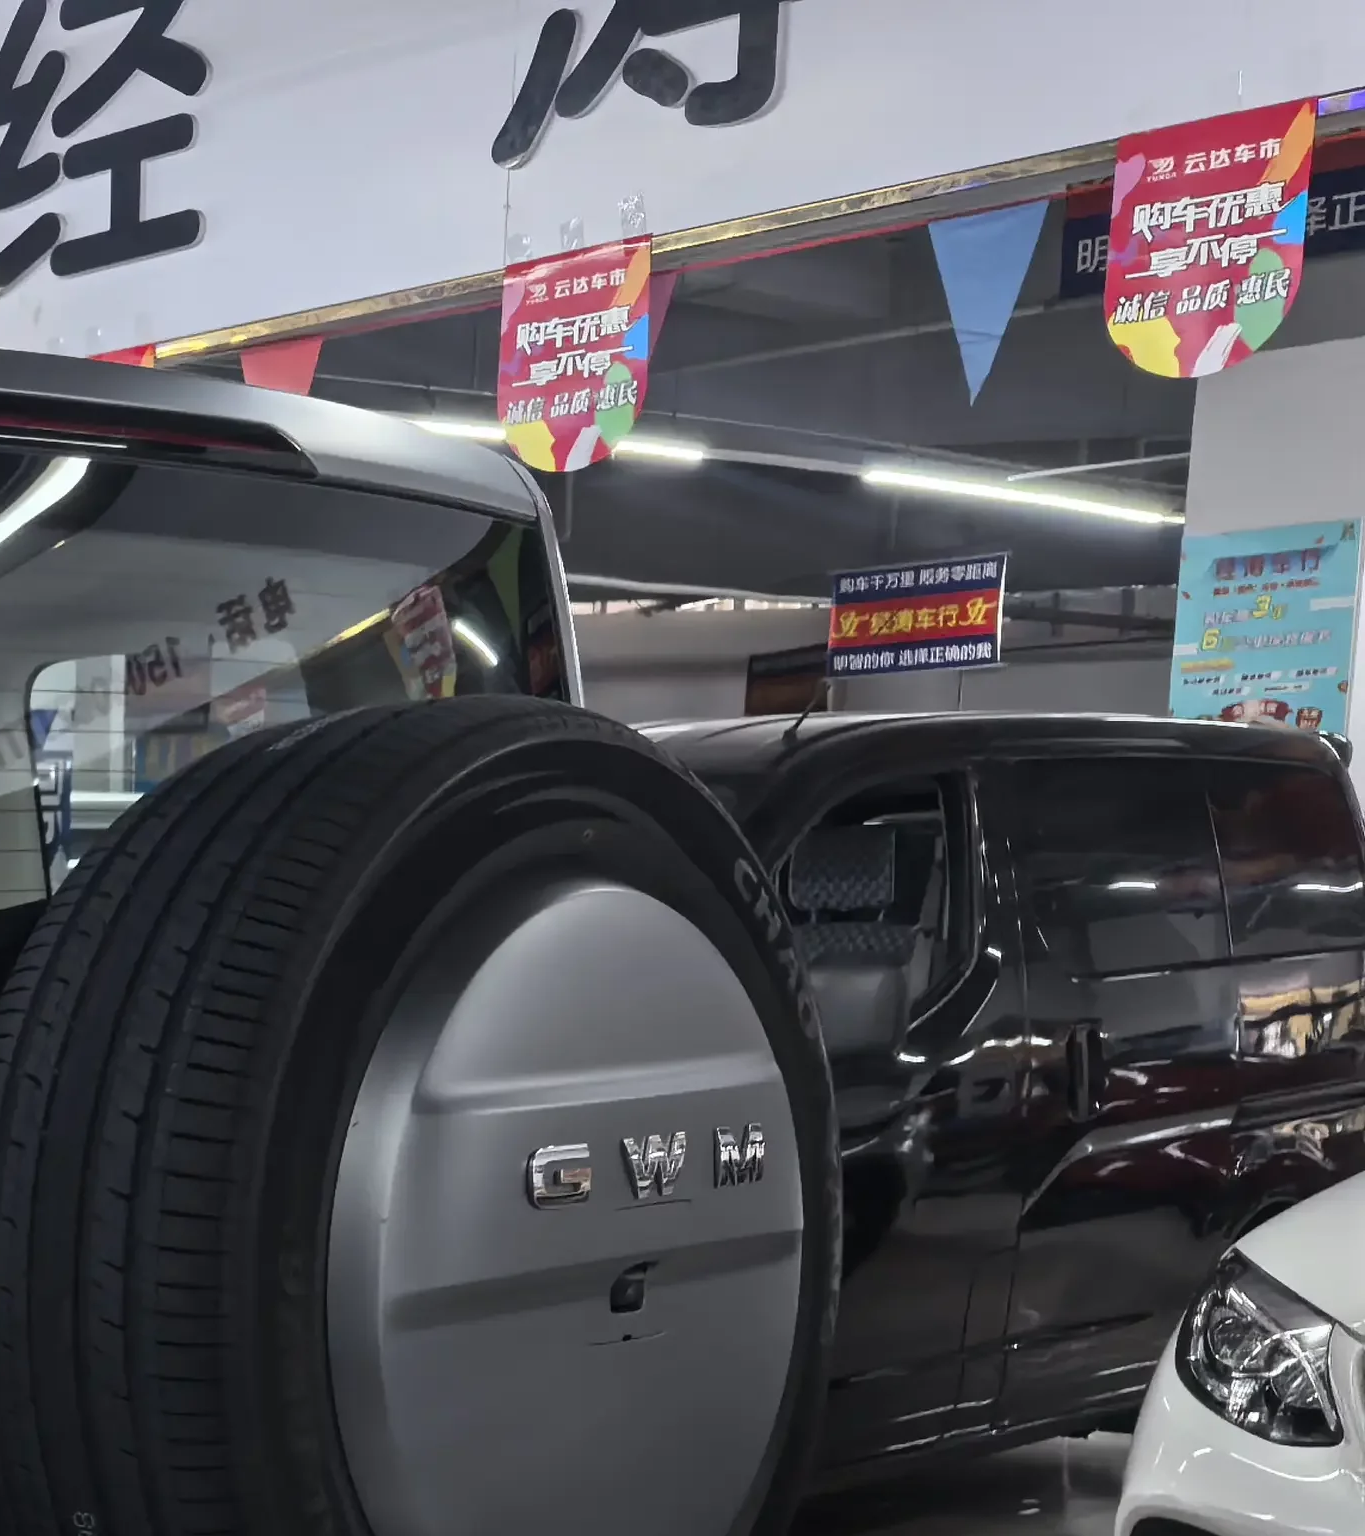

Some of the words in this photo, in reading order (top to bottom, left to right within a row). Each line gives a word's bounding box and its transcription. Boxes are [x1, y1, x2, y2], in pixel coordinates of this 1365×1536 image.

[1184, 137, 1282, 175] 云达车市
[1132, 181, 1292, 242] 购车优惠
[1125, 228, 1286, 279] 享不停
[554, 268, 626, 299] 云达车市
[1113, 290, 1168, 324] 诚信
[1176, 280, 1230, 315] 品质
[1237, 268, 1291, 305] 惠民
[516, 305, 635, 355] 购车优惠
[512, 346, 633, 387] 享不停
[506, 397, 545, 425] 诚信
[550, 388, 591, 417] 品质
[596, 380, 637, 411] 惠民
[526, 1123, 765, 1210] GWM
